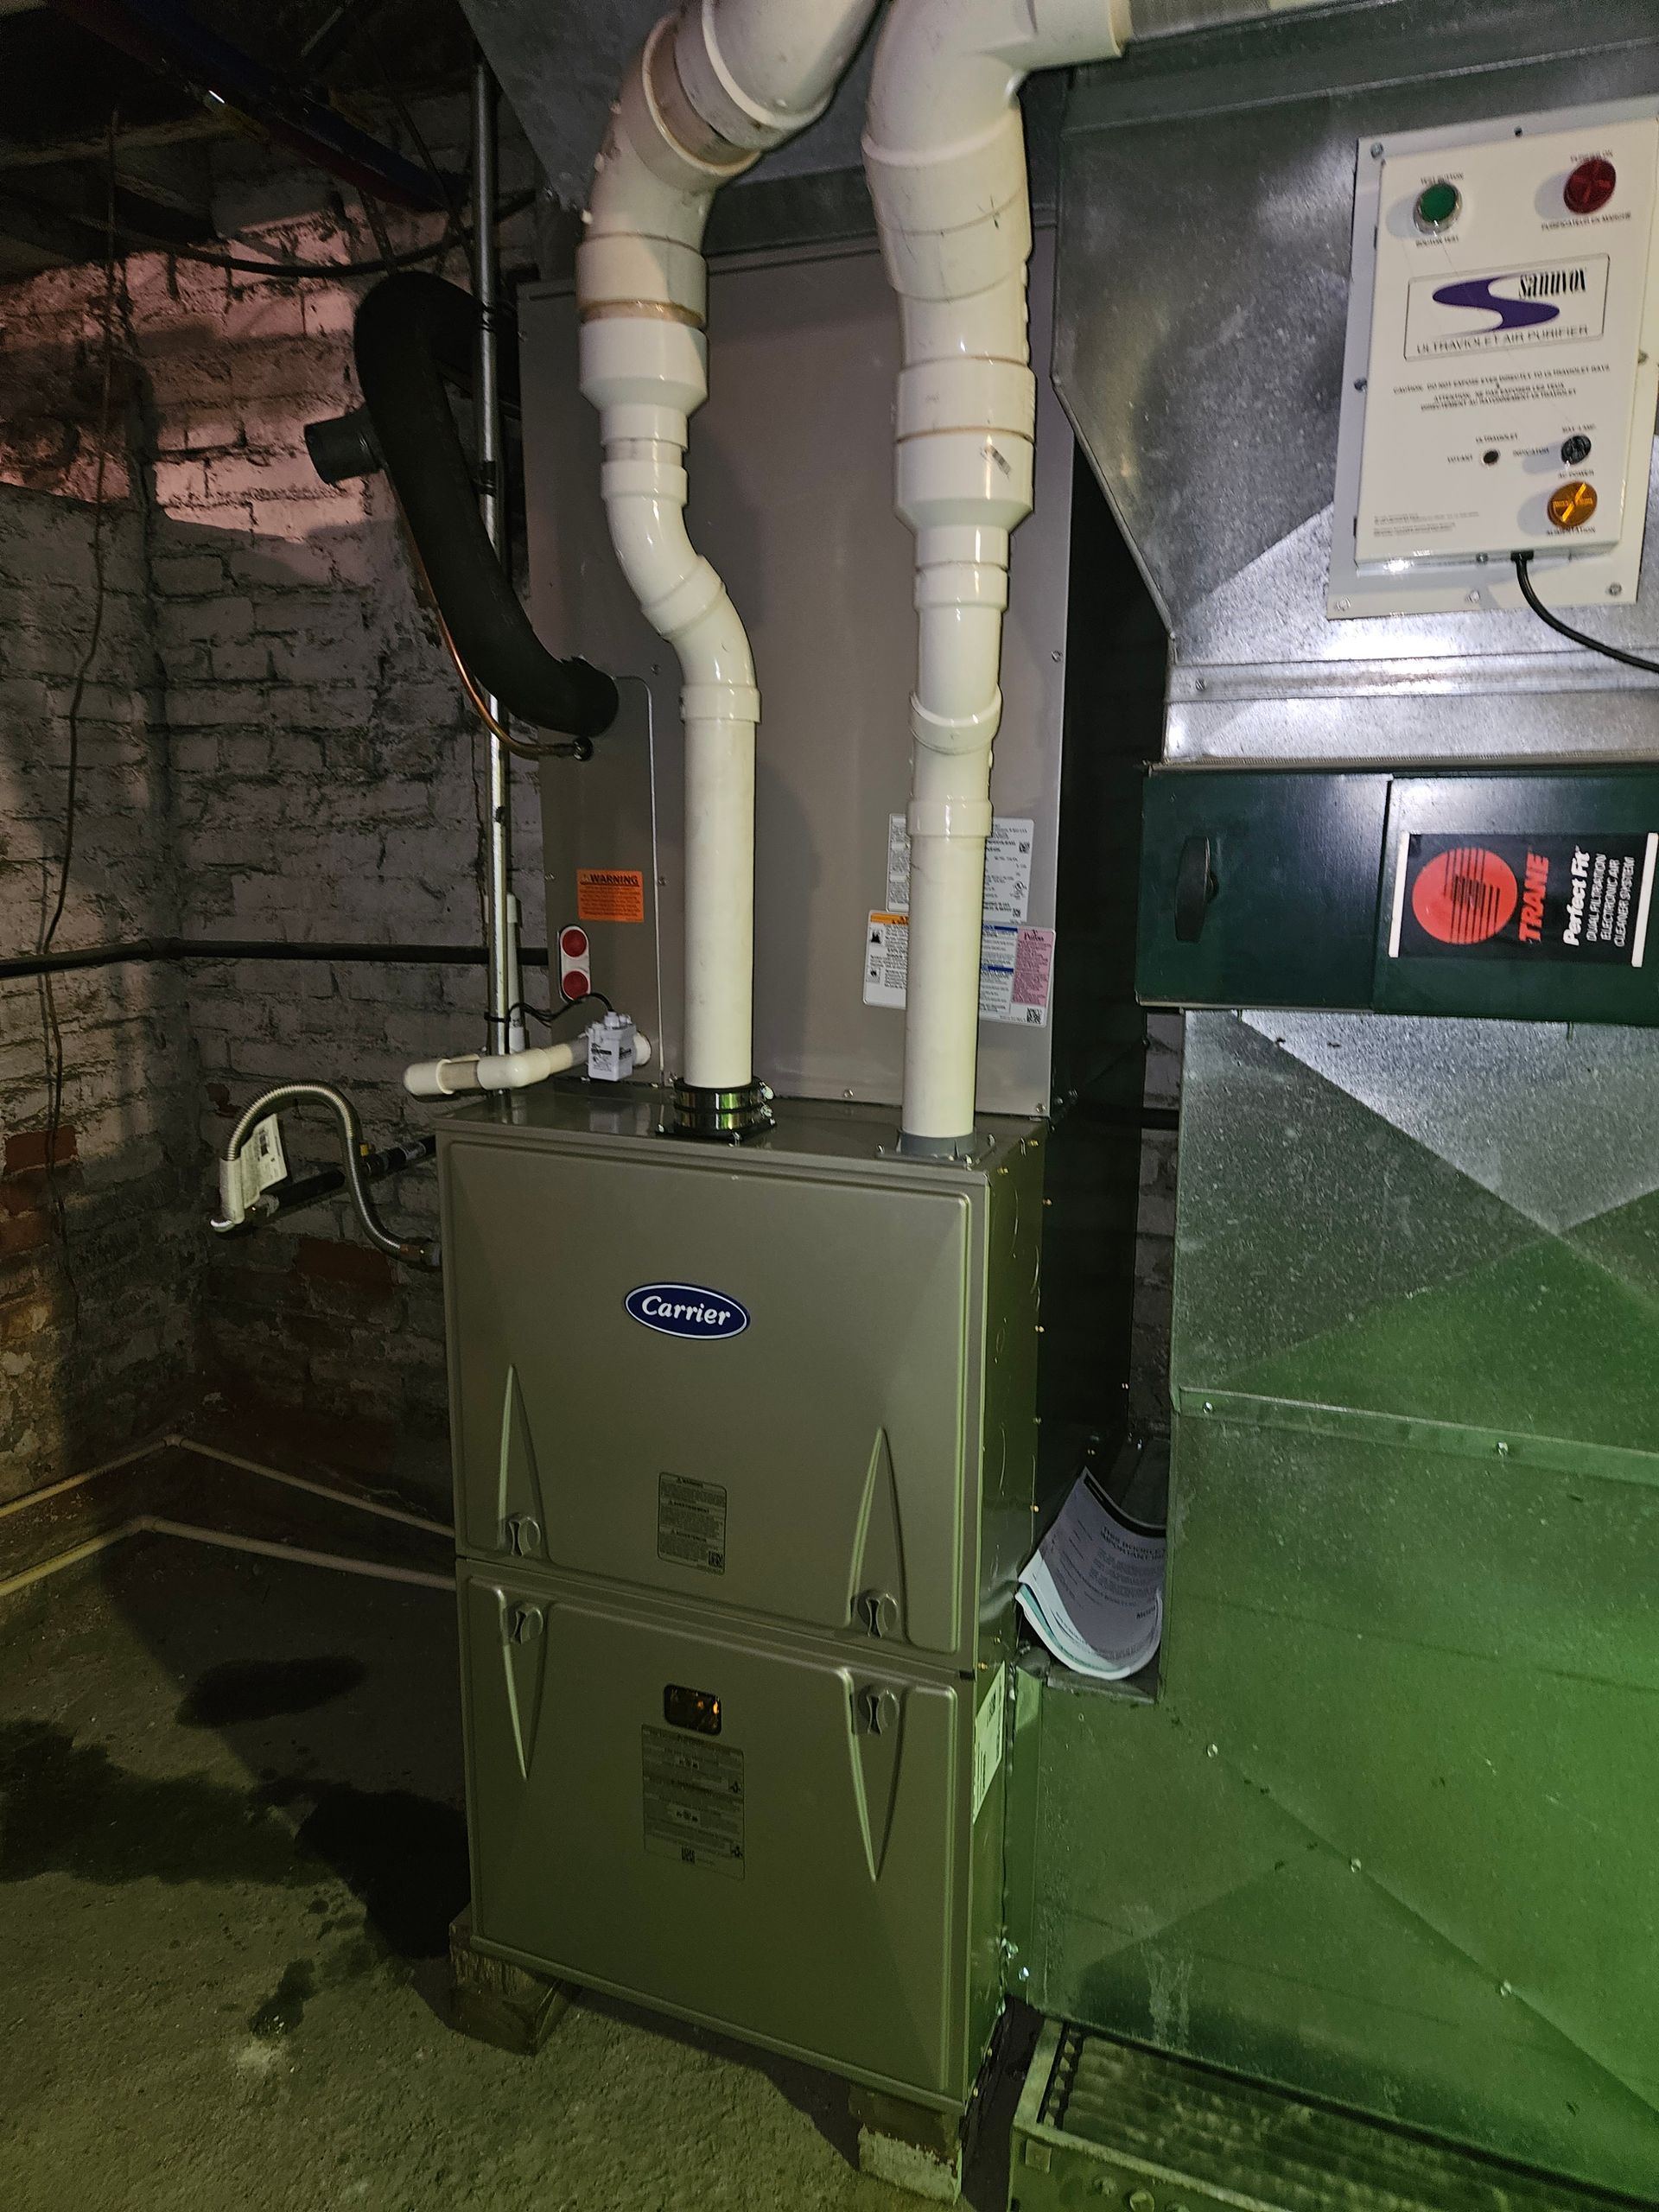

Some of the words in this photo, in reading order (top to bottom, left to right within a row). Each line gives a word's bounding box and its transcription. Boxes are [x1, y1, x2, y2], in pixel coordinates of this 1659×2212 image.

[589, 874, 639, 886] WARNING
[1571, 847, 1591, 878] Fit
[1590, 853, 1607, 913] FILTRATION
[1608, 858, 1621, 879] AIR
[1619, 856, 1636, 901] SYSTEM
[1518, 851, 1549, 943] TRANE
[1562, 877, 1587, 947] Perfect
[1600, 876, 1618, 941] ELECTRONIC
[1586, 912, 1599, 942] DUAL
[1613, 899, 1630, 947] CLEANER
[641, 1295, 731, 1326] Carrier
